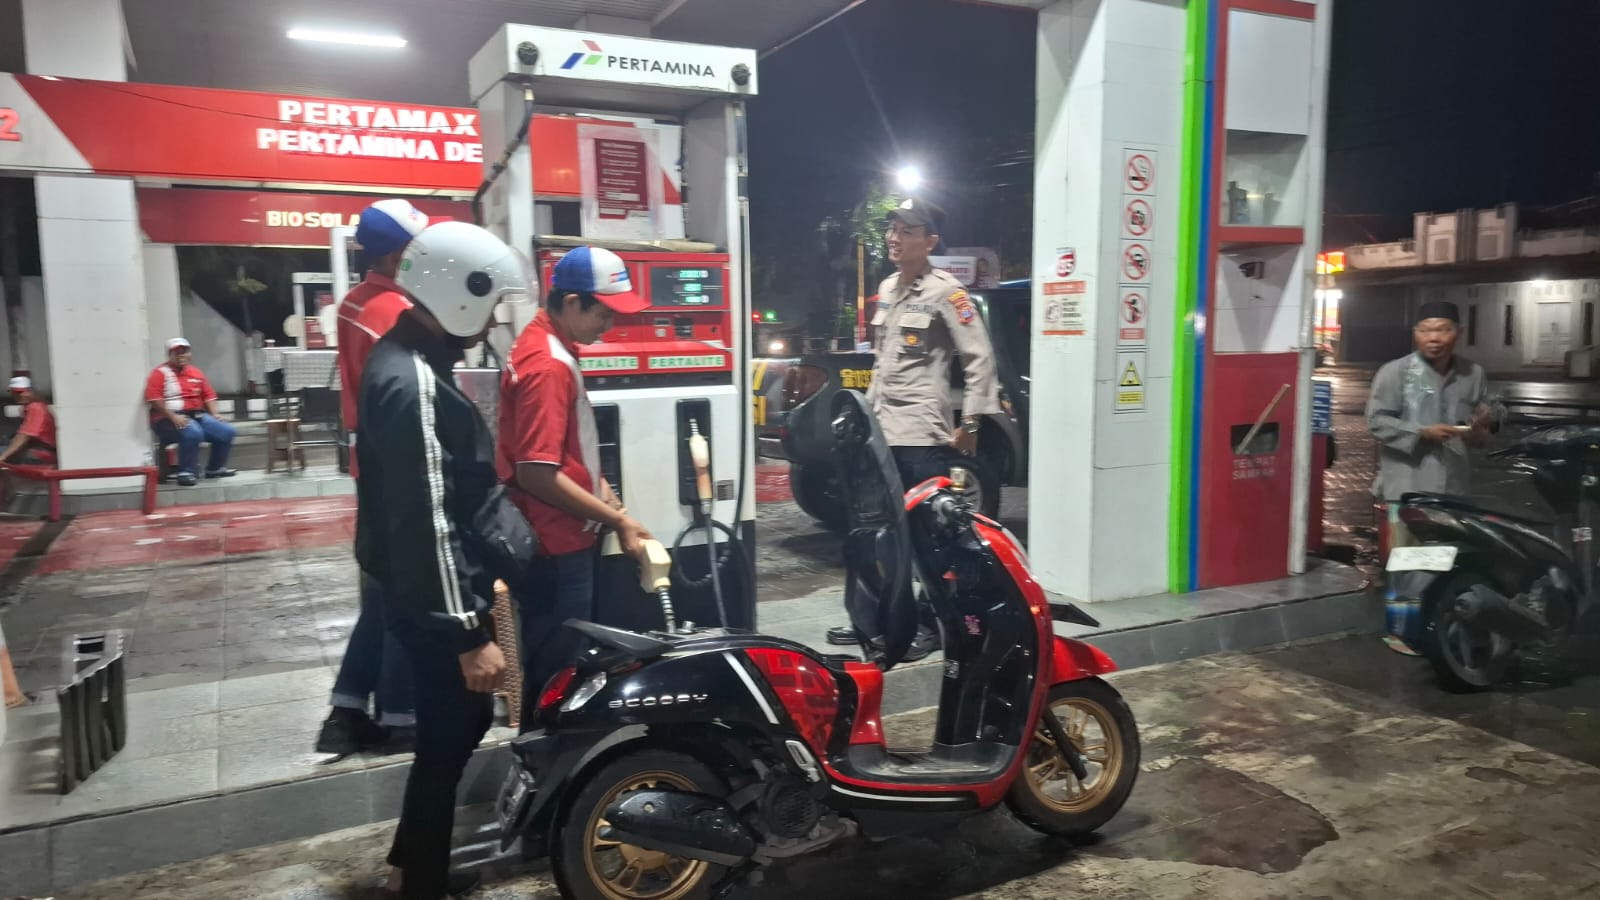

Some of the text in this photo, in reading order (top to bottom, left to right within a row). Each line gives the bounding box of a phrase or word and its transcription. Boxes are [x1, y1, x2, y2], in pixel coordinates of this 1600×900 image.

[608, 55, 716, 78] PERTAMINA
[0, 106, 22, 142] 2
[278, 99, 478, 137] PERTAMAX
[256, 128, 484, 163] PERTAMINA DE
[651, 355, 724, 368] PERTALITE
